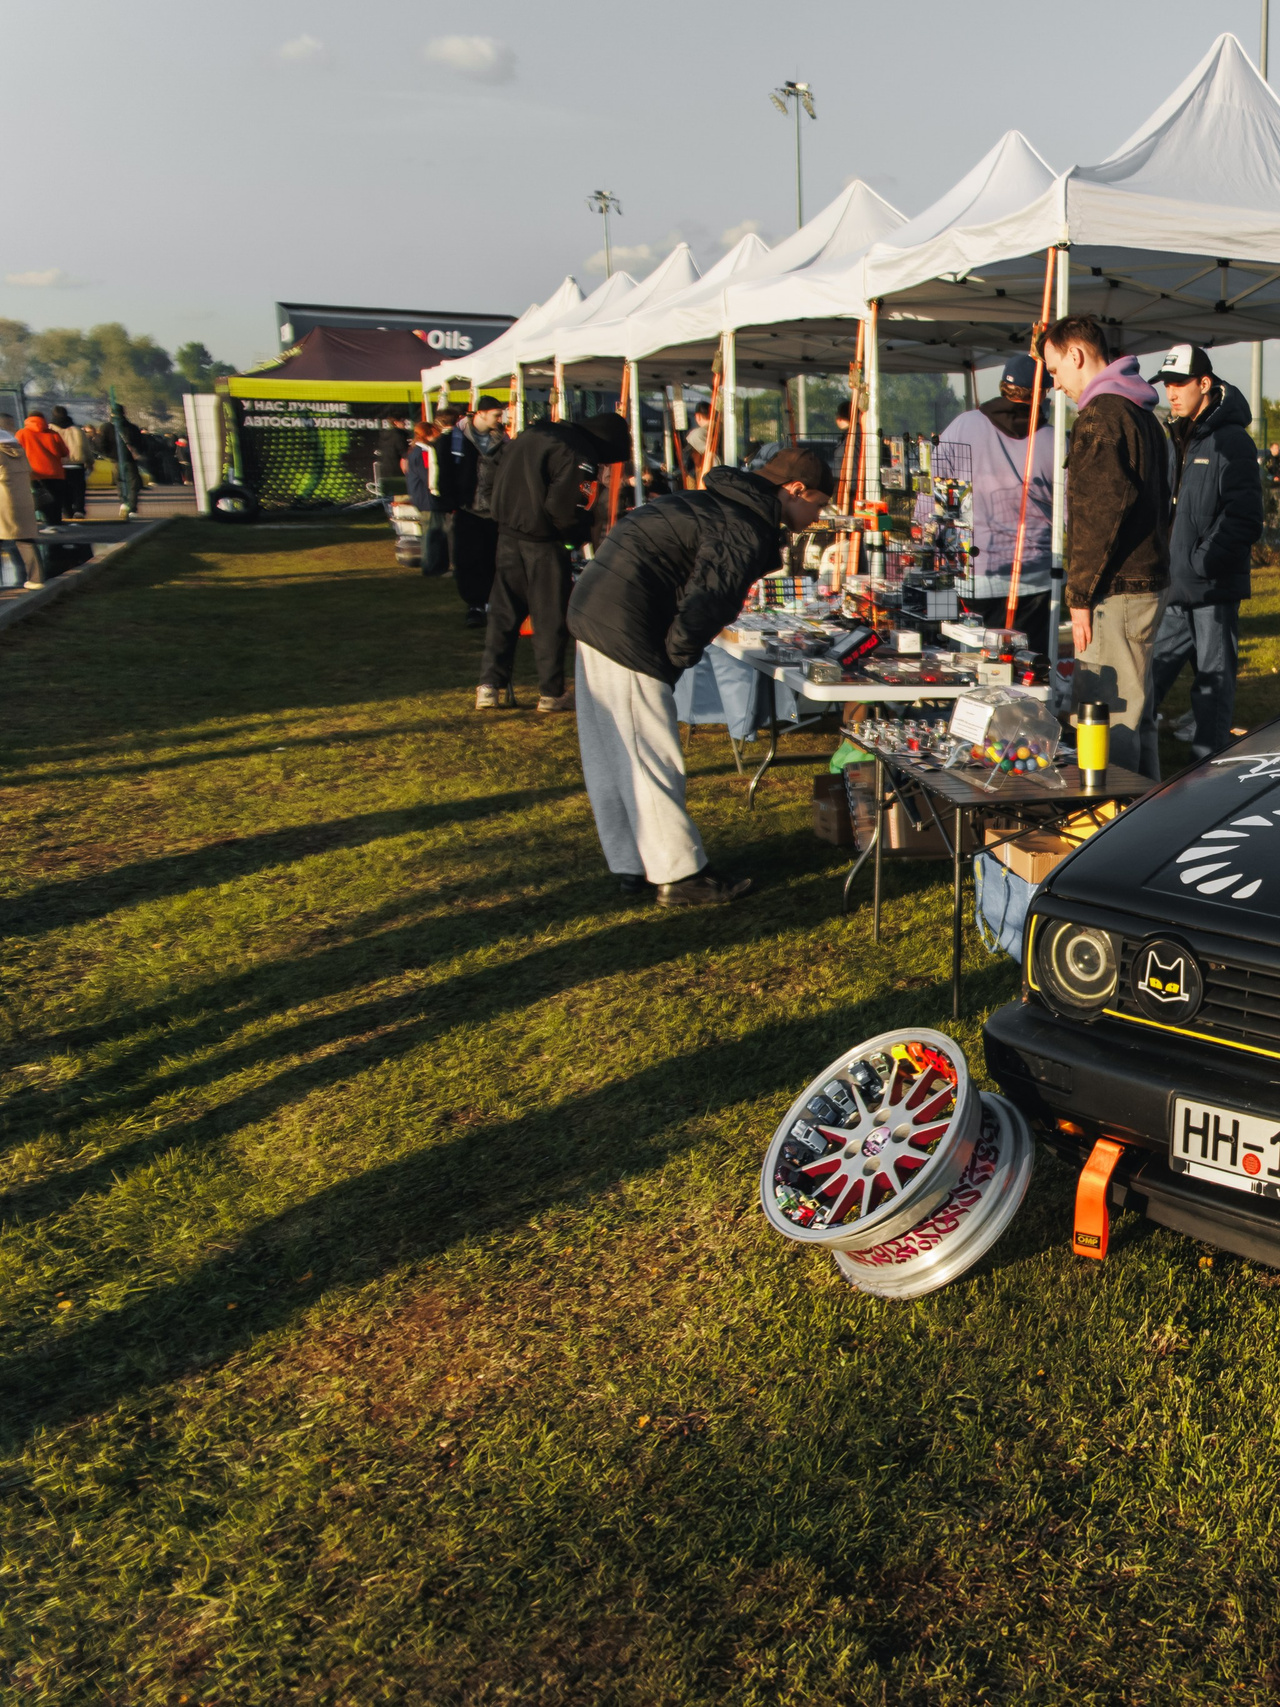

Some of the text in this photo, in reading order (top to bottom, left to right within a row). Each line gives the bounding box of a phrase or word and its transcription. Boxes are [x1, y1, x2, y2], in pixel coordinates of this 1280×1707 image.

[427, 330, 472, 350] Oils
[254, 401, 284, 411] НАС
[287, 401, 348, 413] ЛУЧШИЕ
[1077, 1236, 1098, 1245] OMP
